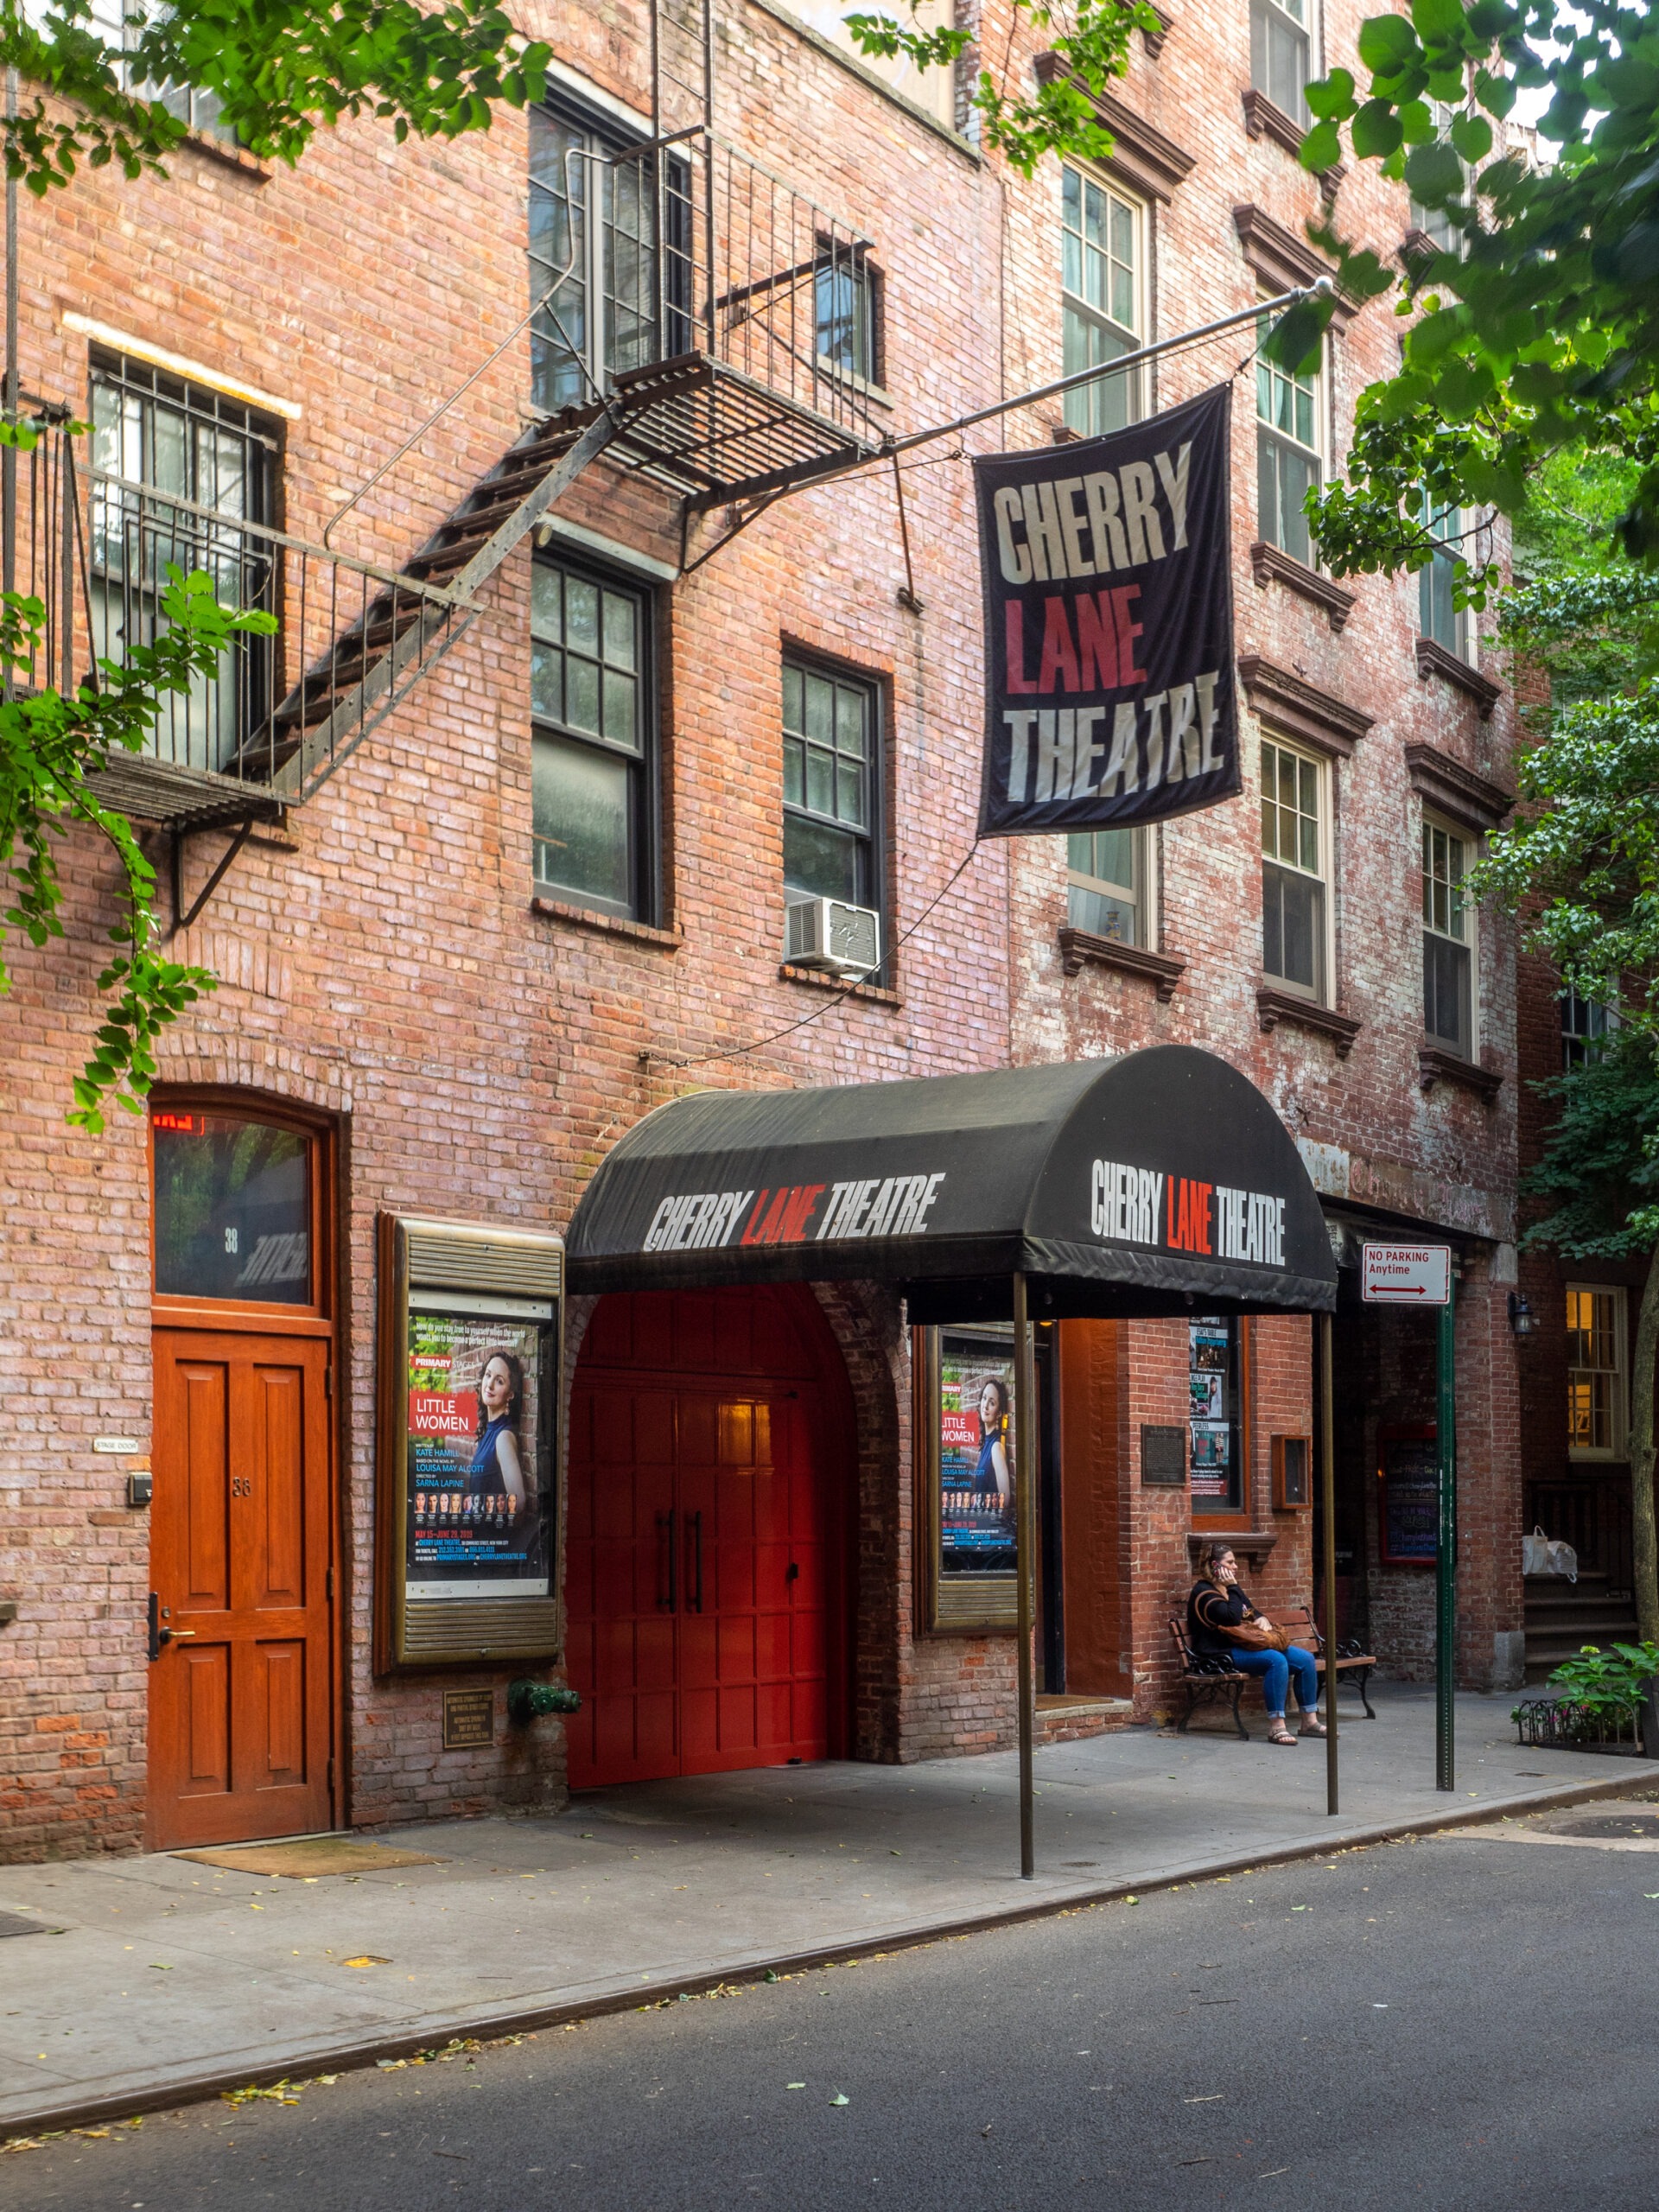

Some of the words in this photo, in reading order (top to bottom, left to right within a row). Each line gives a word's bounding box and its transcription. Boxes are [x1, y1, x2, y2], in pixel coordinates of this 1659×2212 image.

[994, 442, 1192, 584] CHERRY
[1006, 584, 1147, 694] LANE
[1003, 671, 1224, 802] THEATRE
[643, 1190, 754, 1252] CHERRY
[740, 1184, 826, 1245] LANE
[816, 1172, 946, 1240] THEATRE
[1091, 1159, 1163, 1245] CHERRY
[1167, 1175, 1212, 1255] LANE
[1217, 1185, 1285, 1266] THEATRE
[225, 1227, 238, 1254] 38
[1369, 1250, 1382, 1261] NO
[1386, 1251, 1429, 1262] PARKING
[1369, 1263, 1410, 1276] Anytime
[416, 1357, 451, 1368] PRIMARY
[416, 1398, 455, 1414] LITTLE
[416, 1415, 468, 1430] WOMEN
[942, 1430, 975, 1442] WOMEN
[416, 1448, 433, 1457] KATE
[435, 1449, 460, 1458] HAMILL
[459, 1465, 485, 1473] ALCOTT
[232, 1476, 251, 1497] 38
